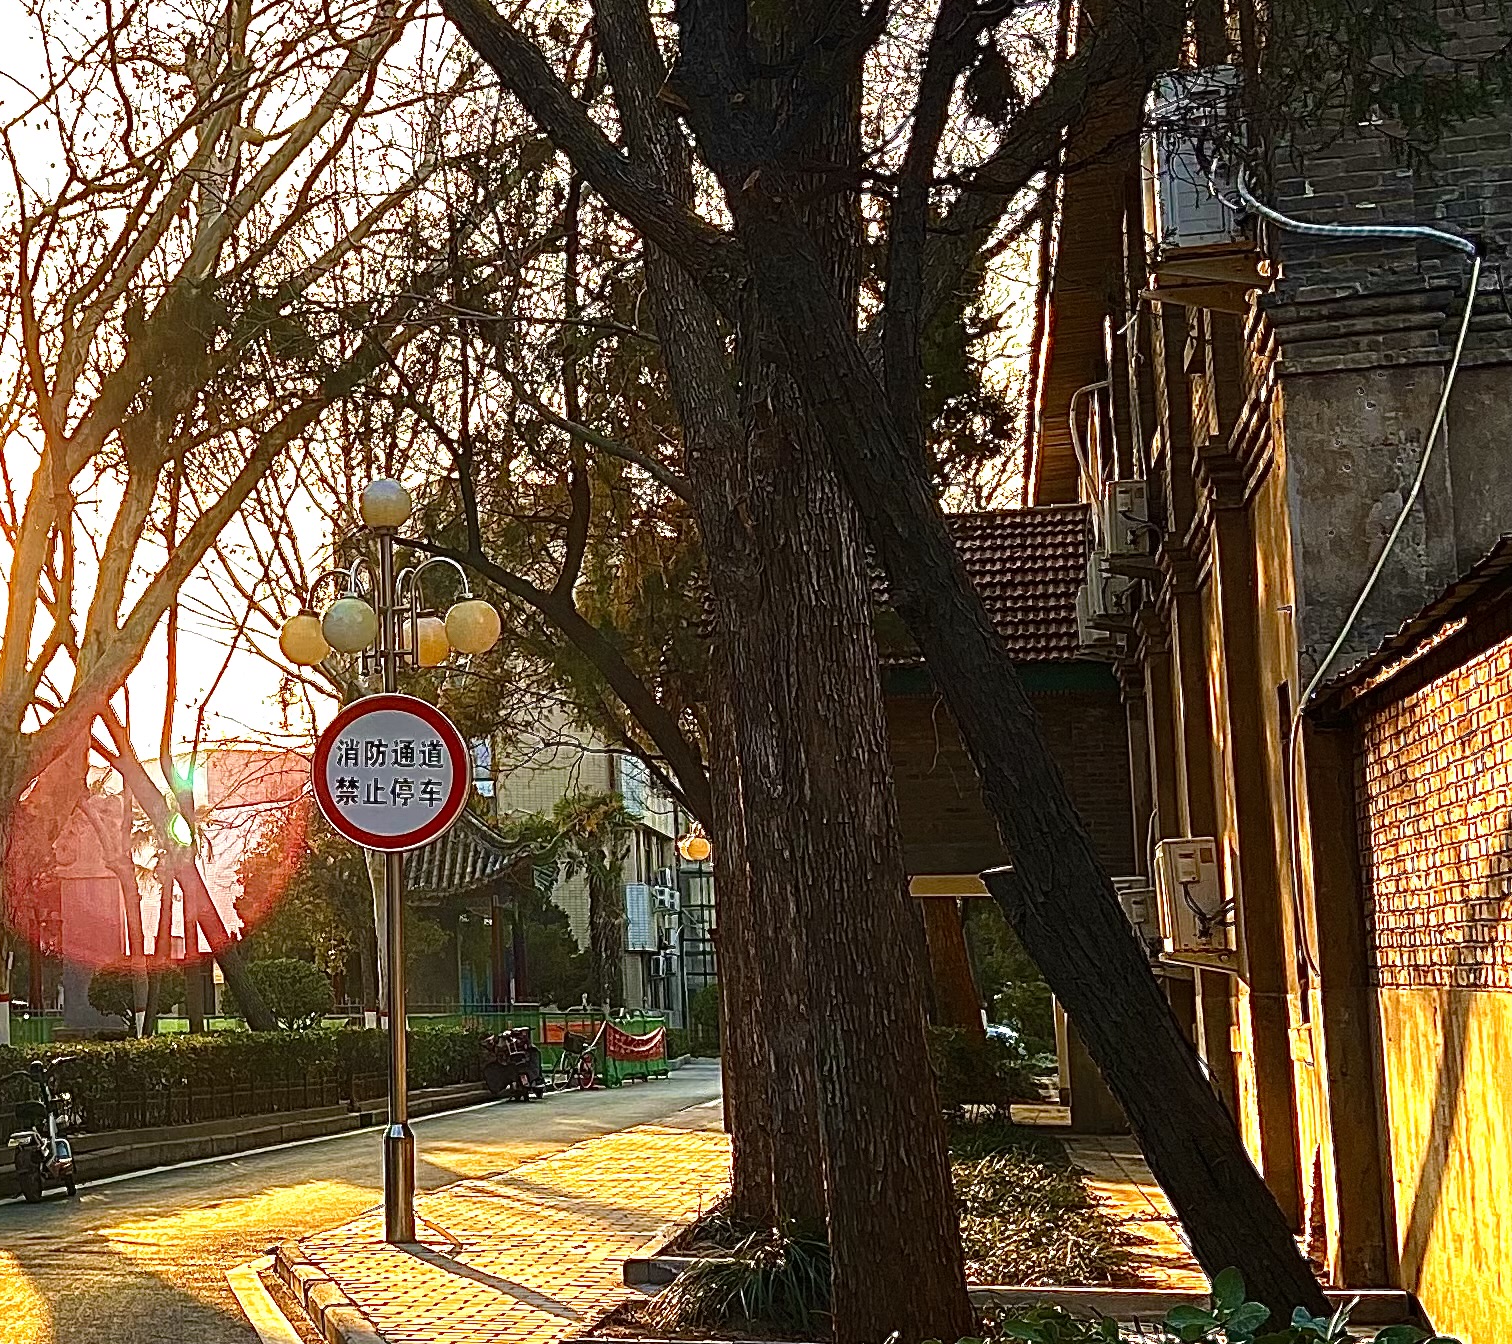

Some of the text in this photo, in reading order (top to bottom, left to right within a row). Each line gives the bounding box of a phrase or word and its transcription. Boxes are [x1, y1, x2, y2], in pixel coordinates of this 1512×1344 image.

[335, 739, 444, 769] 消防通道
[335, 776, 443, 807] 禁止停车
